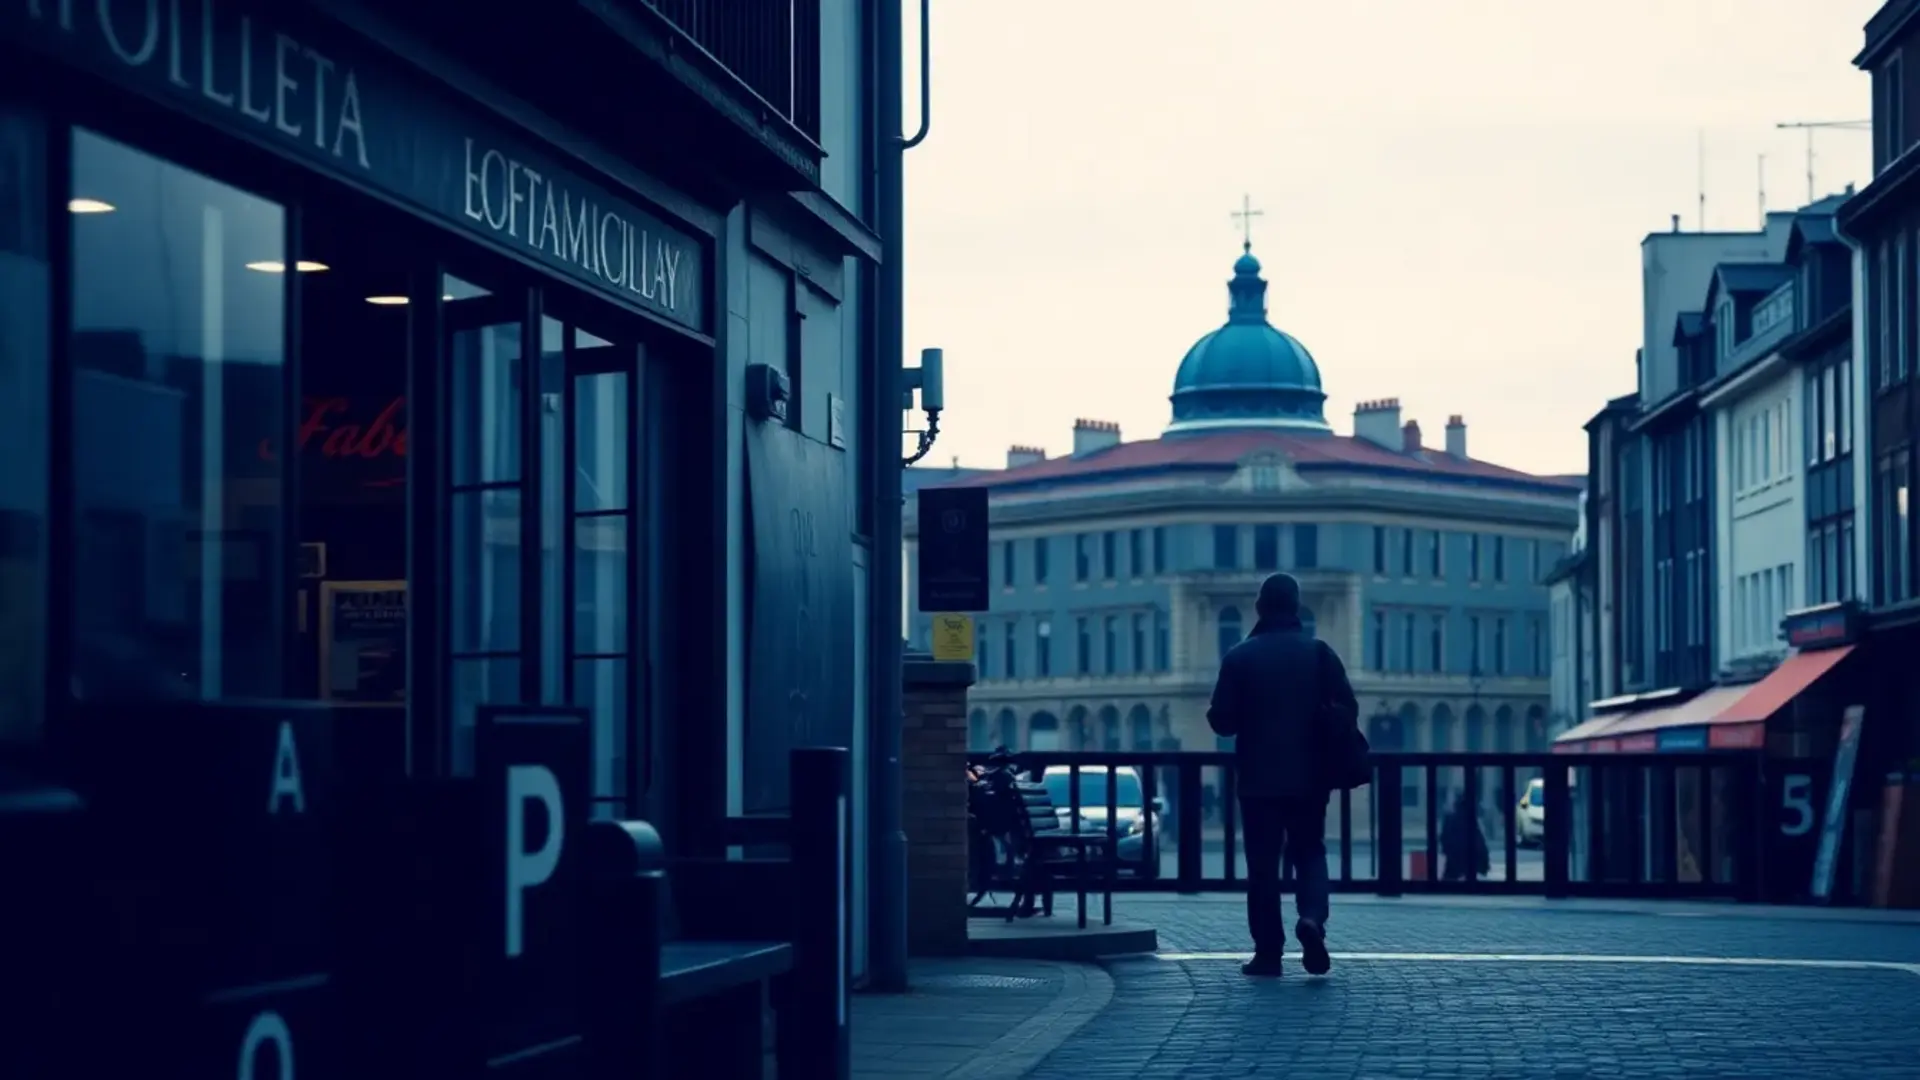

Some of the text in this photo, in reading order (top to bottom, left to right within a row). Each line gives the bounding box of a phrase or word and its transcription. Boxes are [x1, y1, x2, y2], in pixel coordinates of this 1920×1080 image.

[266, 718, 306, 815] A
[1779, 772, 1815, 837] 5
[504, 763, 565, 959] P
